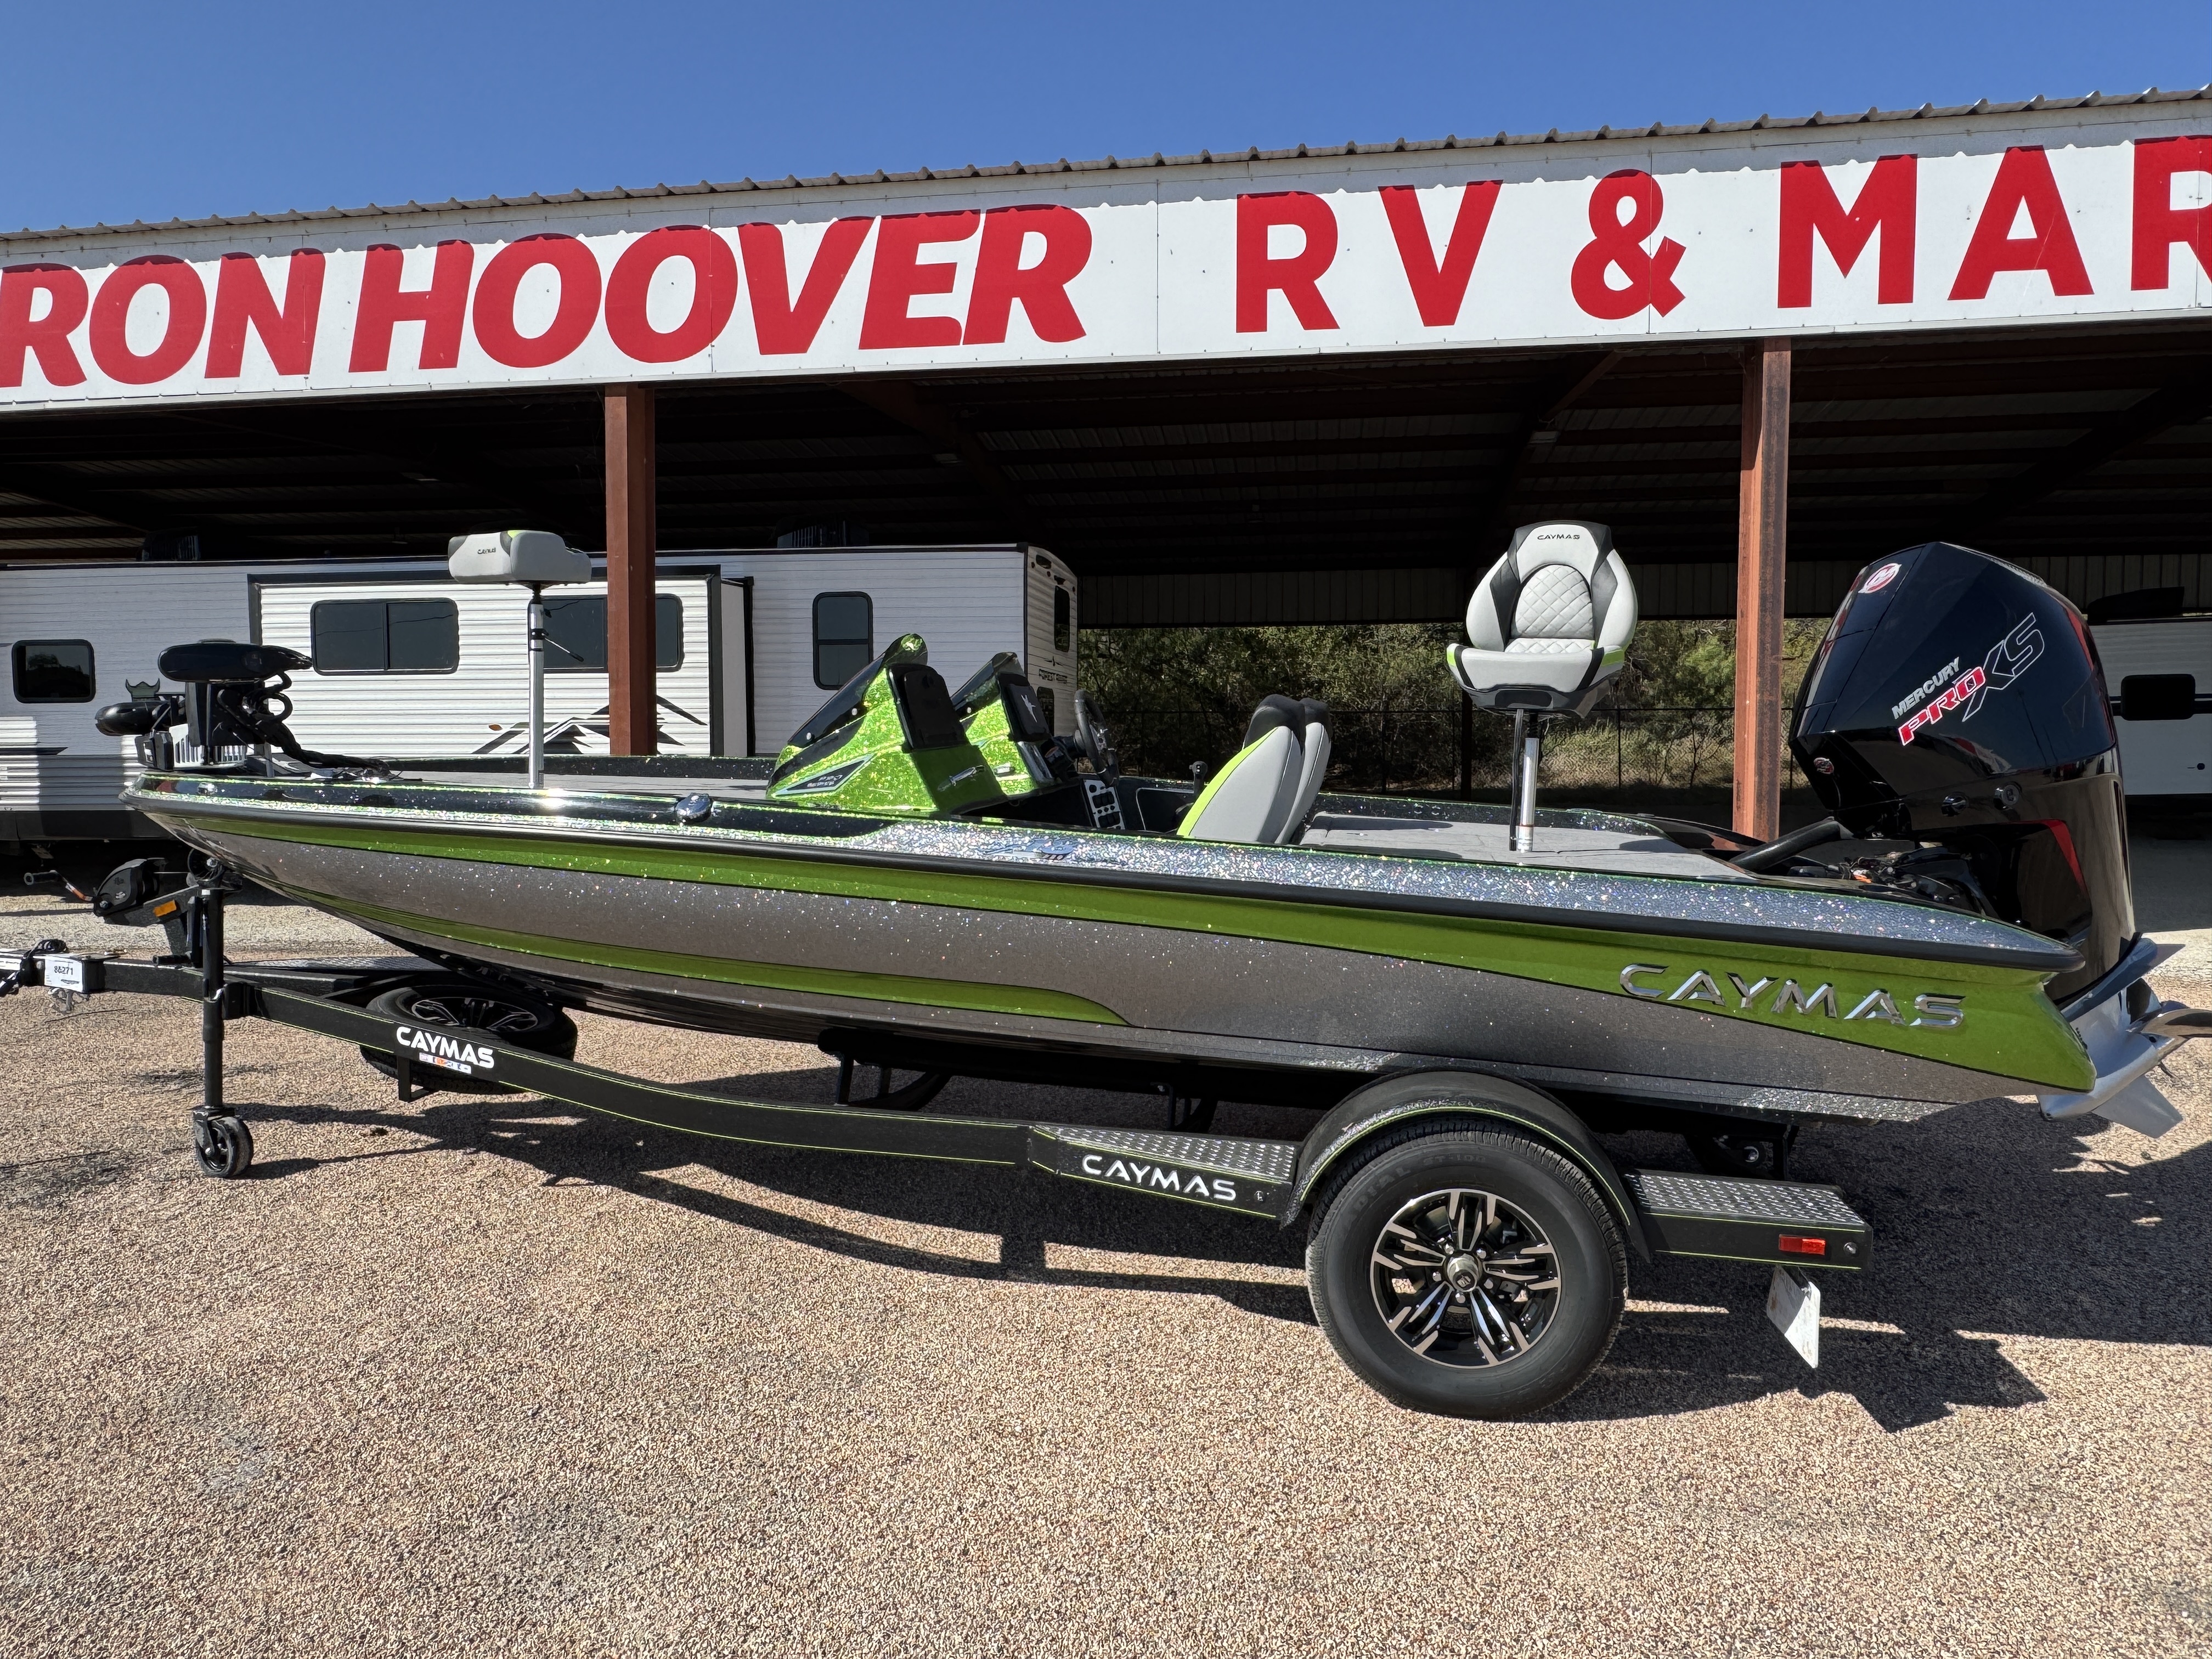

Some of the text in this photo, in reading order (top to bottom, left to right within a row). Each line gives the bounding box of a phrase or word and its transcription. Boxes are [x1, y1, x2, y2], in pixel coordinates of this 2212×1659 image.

[0, 250, 326, 388] RON
[348, 204, 1092, 373] HOOVER
[1236, 179, 1503, 333] RV
[1571, 168, 1686, 320] &
[1892, 657, 1959, 720] MERCURY
[1898, 666, 1986, 746] PRO
[1619, 963, 1966, 1028] CAYMAS
[396, 1026, 495, 1069] CAYMAS
[1082, 1154, 1237, 1201] CAYMAS
